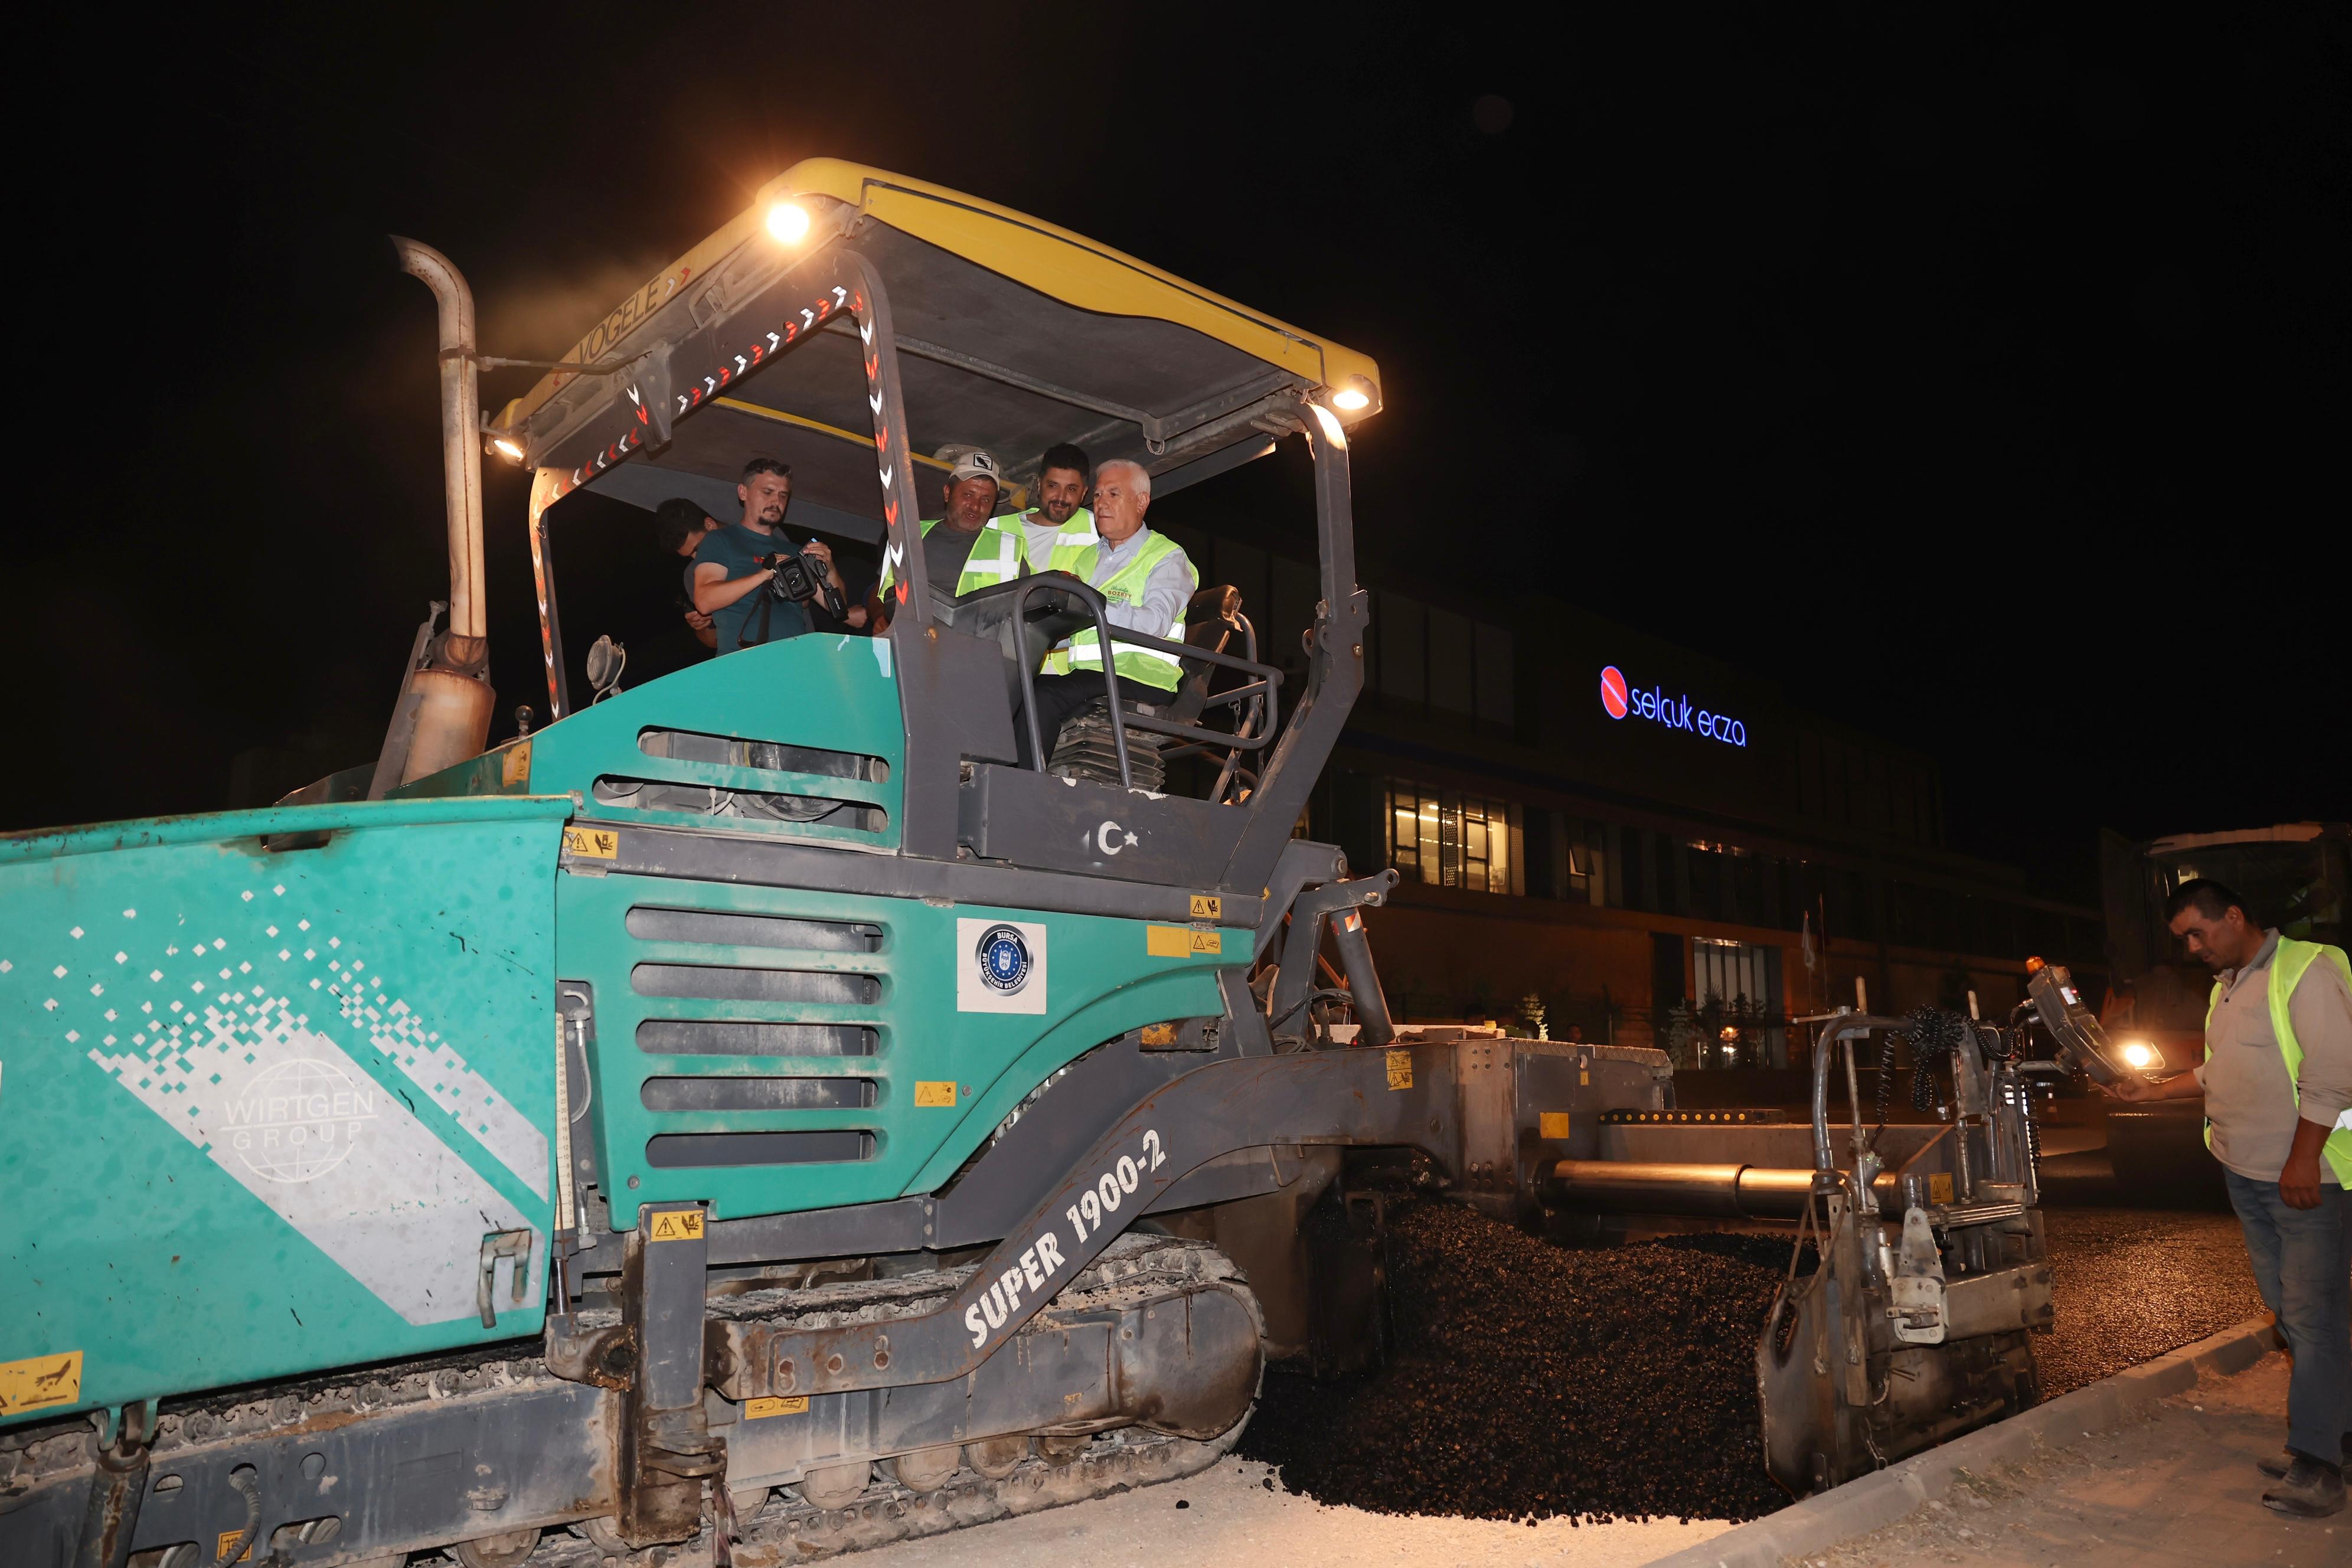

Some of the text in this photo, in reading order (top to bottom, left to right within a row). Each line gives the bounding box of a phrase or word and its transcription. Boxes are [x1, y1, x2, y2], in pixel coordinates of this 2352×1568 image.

[1108, 590, 1132, 599] BOZBEY
[1632, 685, 1747, 747] selçuk ecza
[997, 932, 1018, 944] BURSA
[982, 952, 1027, 989] BÜYÜKŞEHİR BELEDİYESİ
[224, 1090, 373, 1125] WIRTGEN
[233, 1122, 361, 1150] GROUP
[965, 1129, 1166, 1349] SUPER 1900-2
